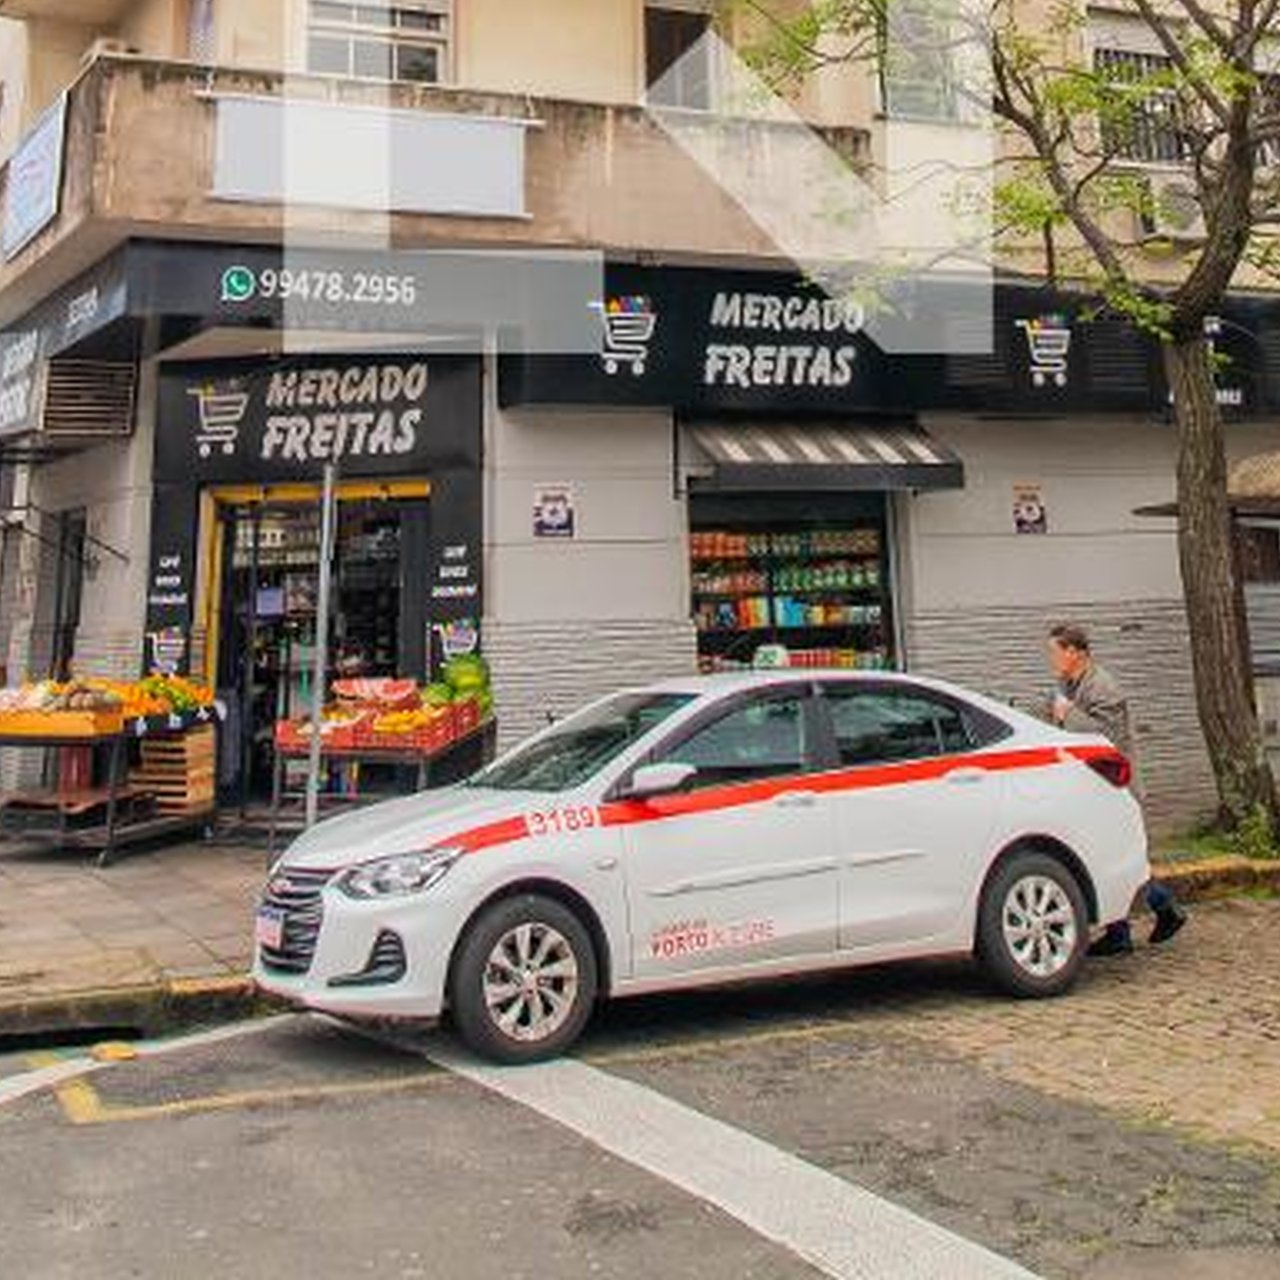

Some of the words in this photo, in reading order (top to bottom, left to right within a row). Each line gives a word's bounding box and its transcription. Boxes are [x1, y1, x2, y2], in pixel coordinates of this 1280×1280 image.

[260, 268, 417, 306] 99478.2956
[708, 291, 865, 334] MERCADO
[265, 361, 429, 407] MERCADO
[704, 343, 857, 389] FREITAS
[258, 407, 422, 461] FREITAS
[531, 805, 595, 835] 3189
